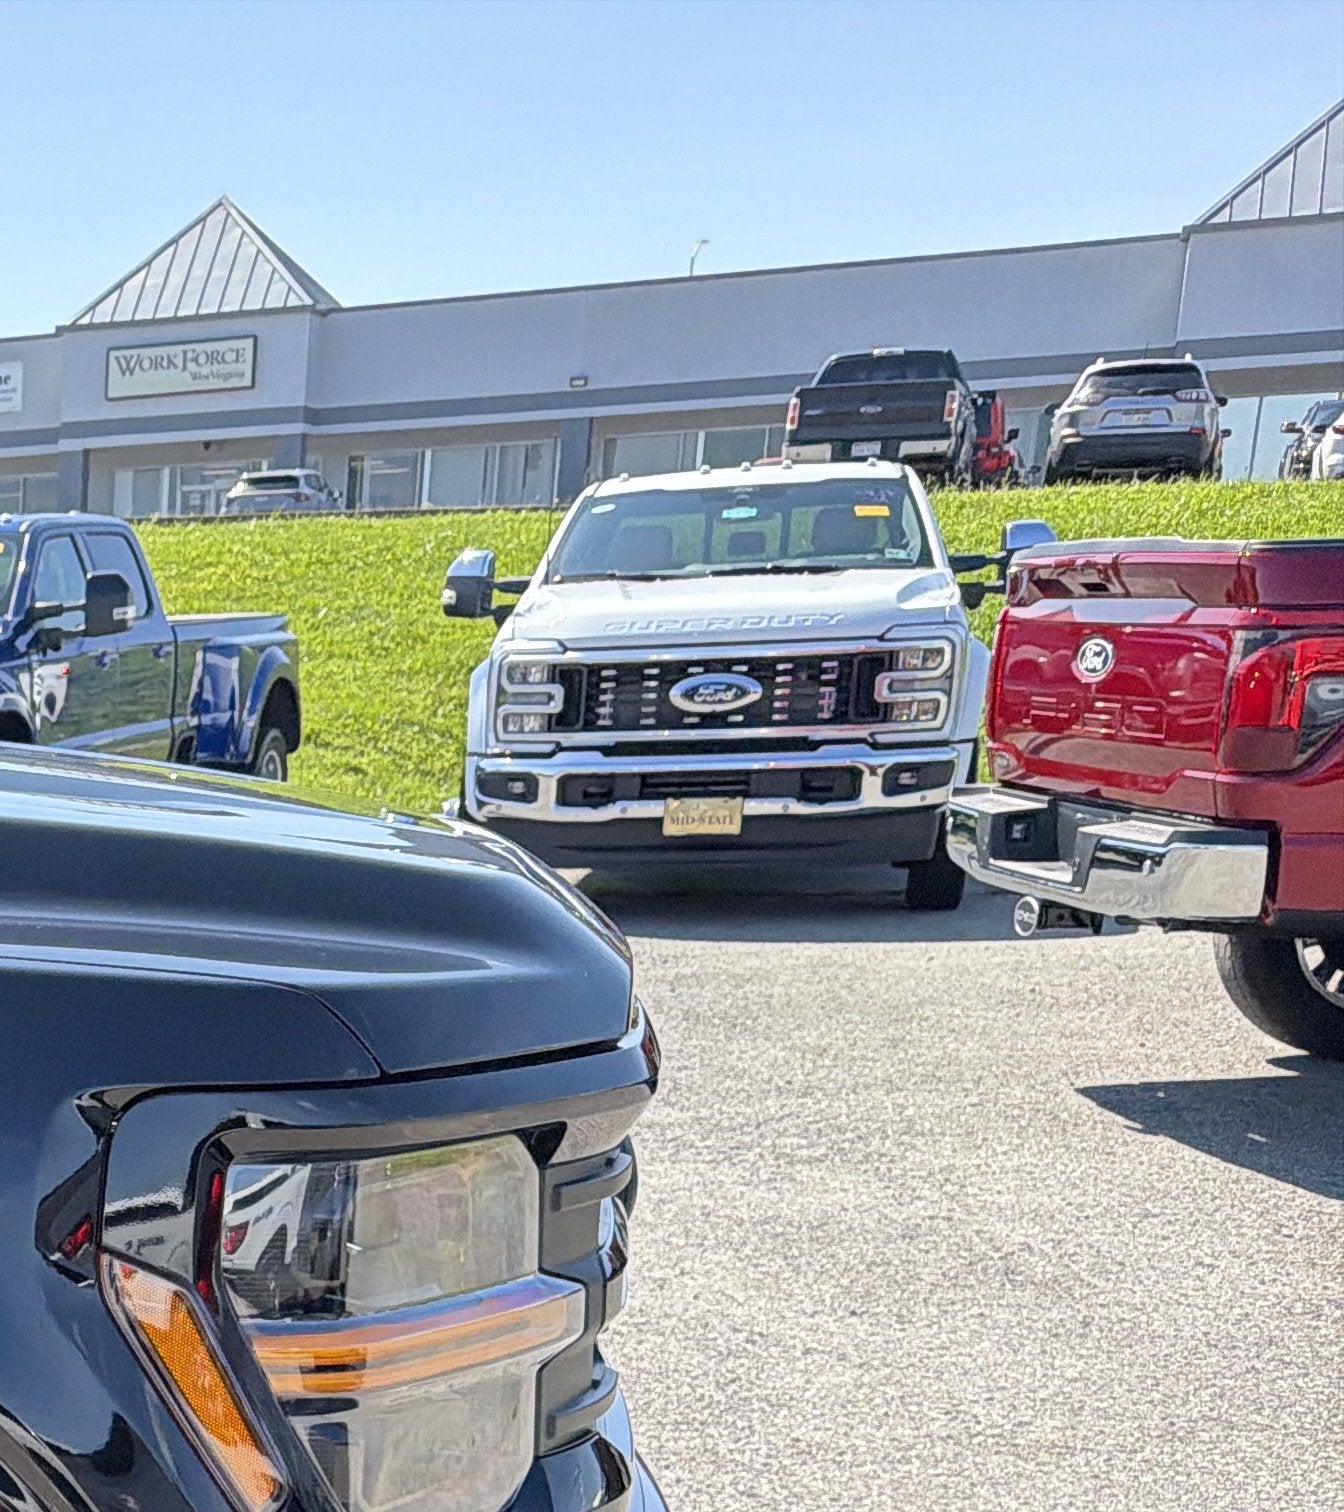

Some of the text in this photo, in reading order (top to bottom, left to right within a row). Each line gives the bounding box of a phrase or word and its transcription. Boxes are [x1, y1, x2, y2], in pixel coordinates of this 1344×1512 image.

[603, 611, 845, 634] SUPER DUTY
[1081, 643, 1107, 670] Ford
[693, 683, 738, 702] Ford
